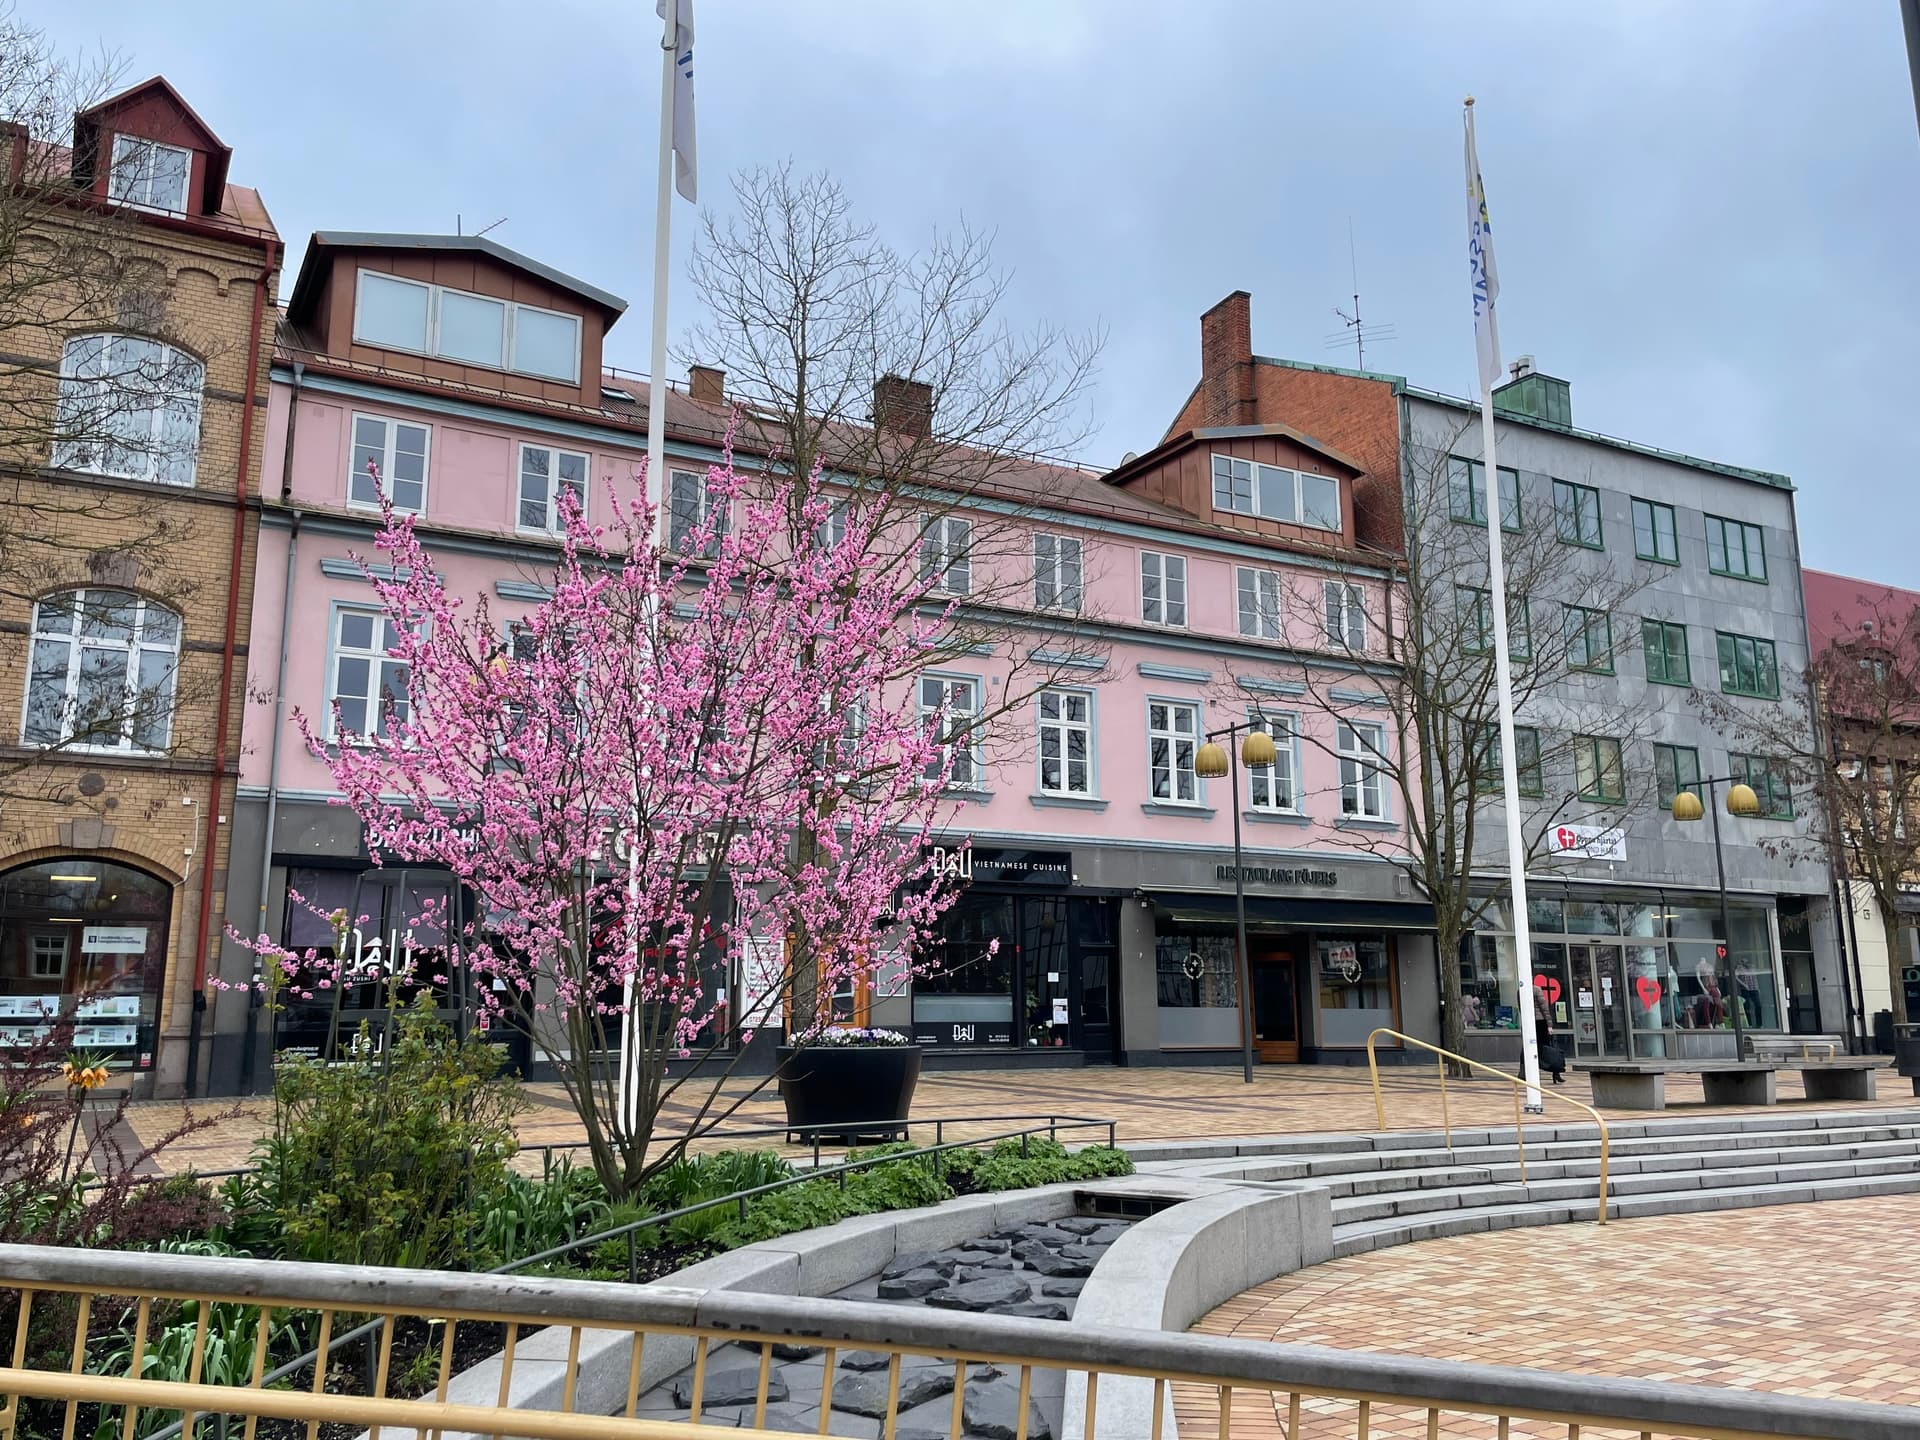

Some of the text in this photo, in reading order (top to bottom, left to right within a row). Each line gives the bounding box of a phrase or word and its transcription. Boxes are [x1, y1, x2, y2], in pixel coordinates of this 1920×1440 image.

[974, 860, 1028, 870] VIETNAMESE
[1032, 863, 1067, 872] CUISINE
[1216, 865, 1294, 884] RESTAURANG
